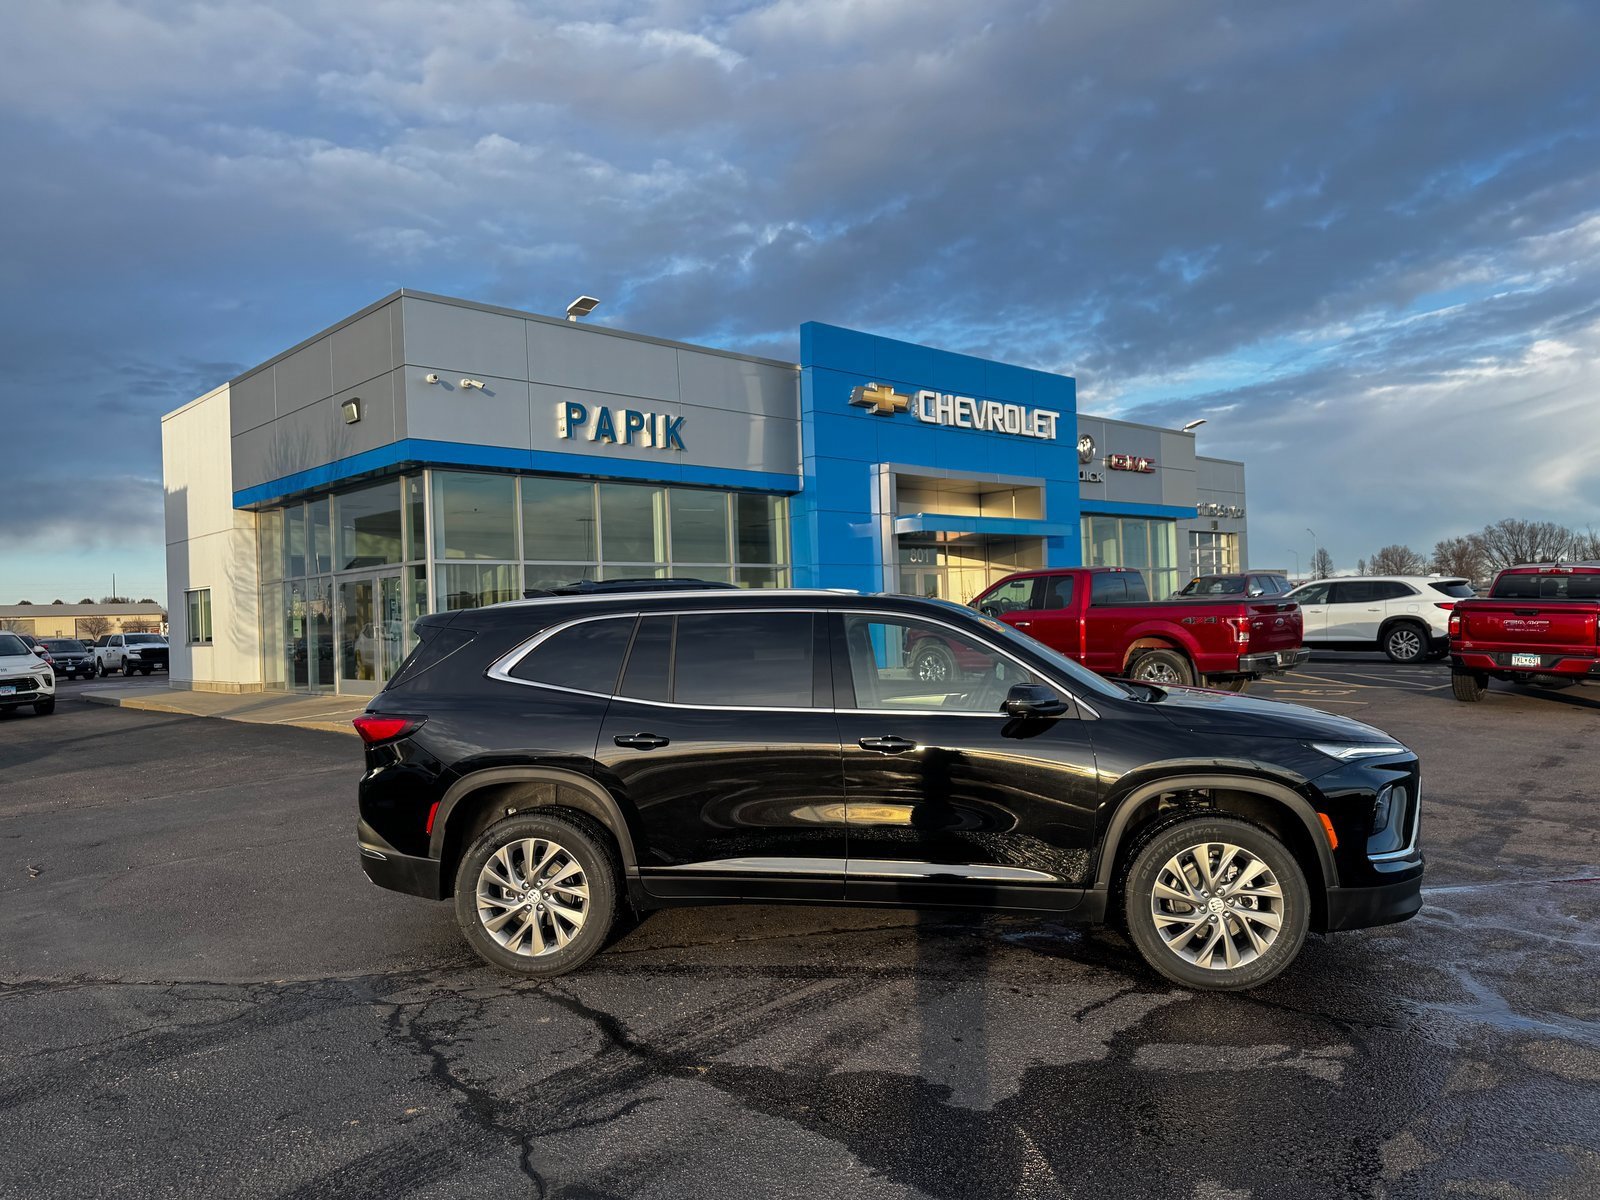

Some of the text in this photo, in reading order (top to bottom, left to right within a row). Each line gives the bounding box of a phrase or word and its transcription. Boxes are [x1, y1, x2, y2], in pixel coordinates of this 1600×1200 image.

[916, 389, 1060, 440] CHEVROLET
[560, 401, 686, 450] PAPIK
[1106, 454, 1155, 473] GMC
[1079, 470, 1105, 482] UICK
[1219, 504, 1246, 520] Service
[910, 548, 929, 563] 801
[1141, 827, 1222, 880] CONTINENTAL
